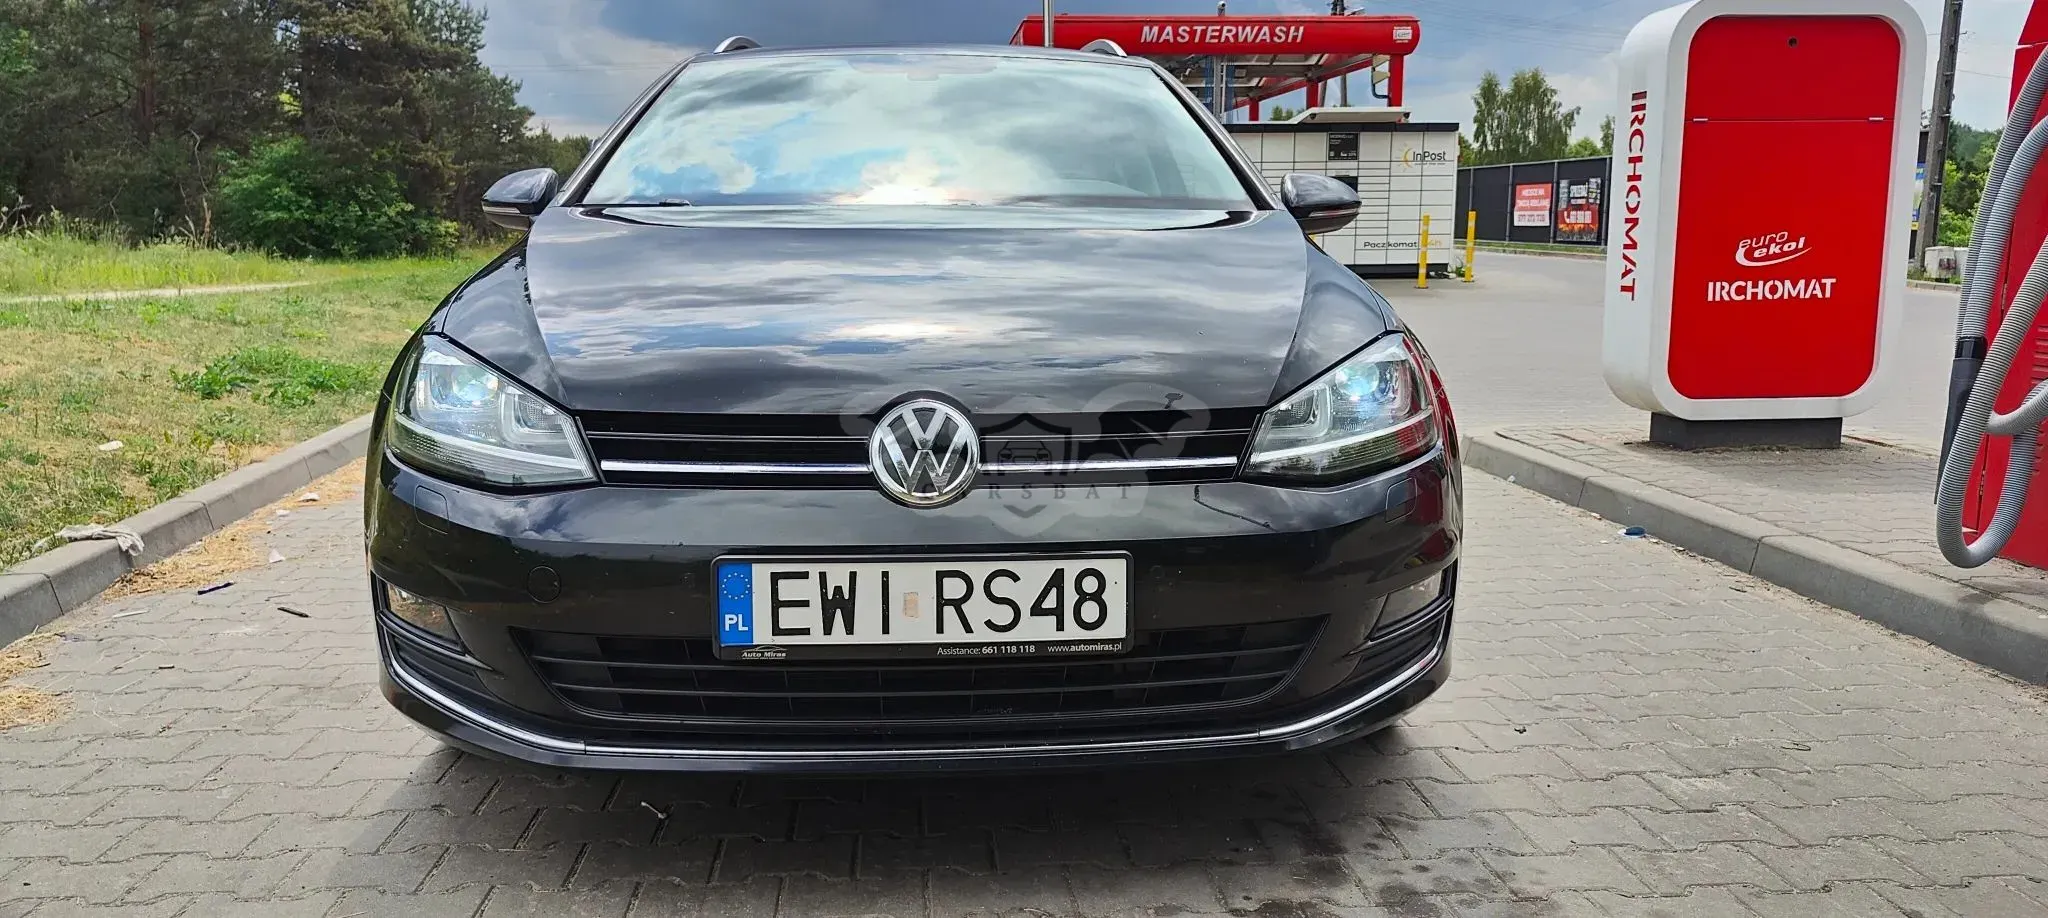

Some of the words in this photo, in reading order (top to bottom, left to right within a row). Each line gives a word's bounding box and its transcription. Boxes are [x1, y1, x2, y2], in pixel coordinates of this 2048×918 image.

[1141, 25, 1304, 43] MASTERWASH
[1412, 151, 1446, 161] InPost
[1620, 90, 1648, 301] IRCHOMAT
[1738, 231, 1788, 249] euro
[1753, 236, 1805, 258] ekol
[1707, 278, 1837, 301] IRCHOMAT
[770, 570, 890, 636] EWI
[935, 567, 1108, 634] RS48
[724, 614, 748, 631] PL
[937, 647, 981, 655] Assistance:
[982, 646, 998, 654] 661
[1019, 645, 1035, 653] 118
[1048, 642, 1122, 652] www.automiras.pl
